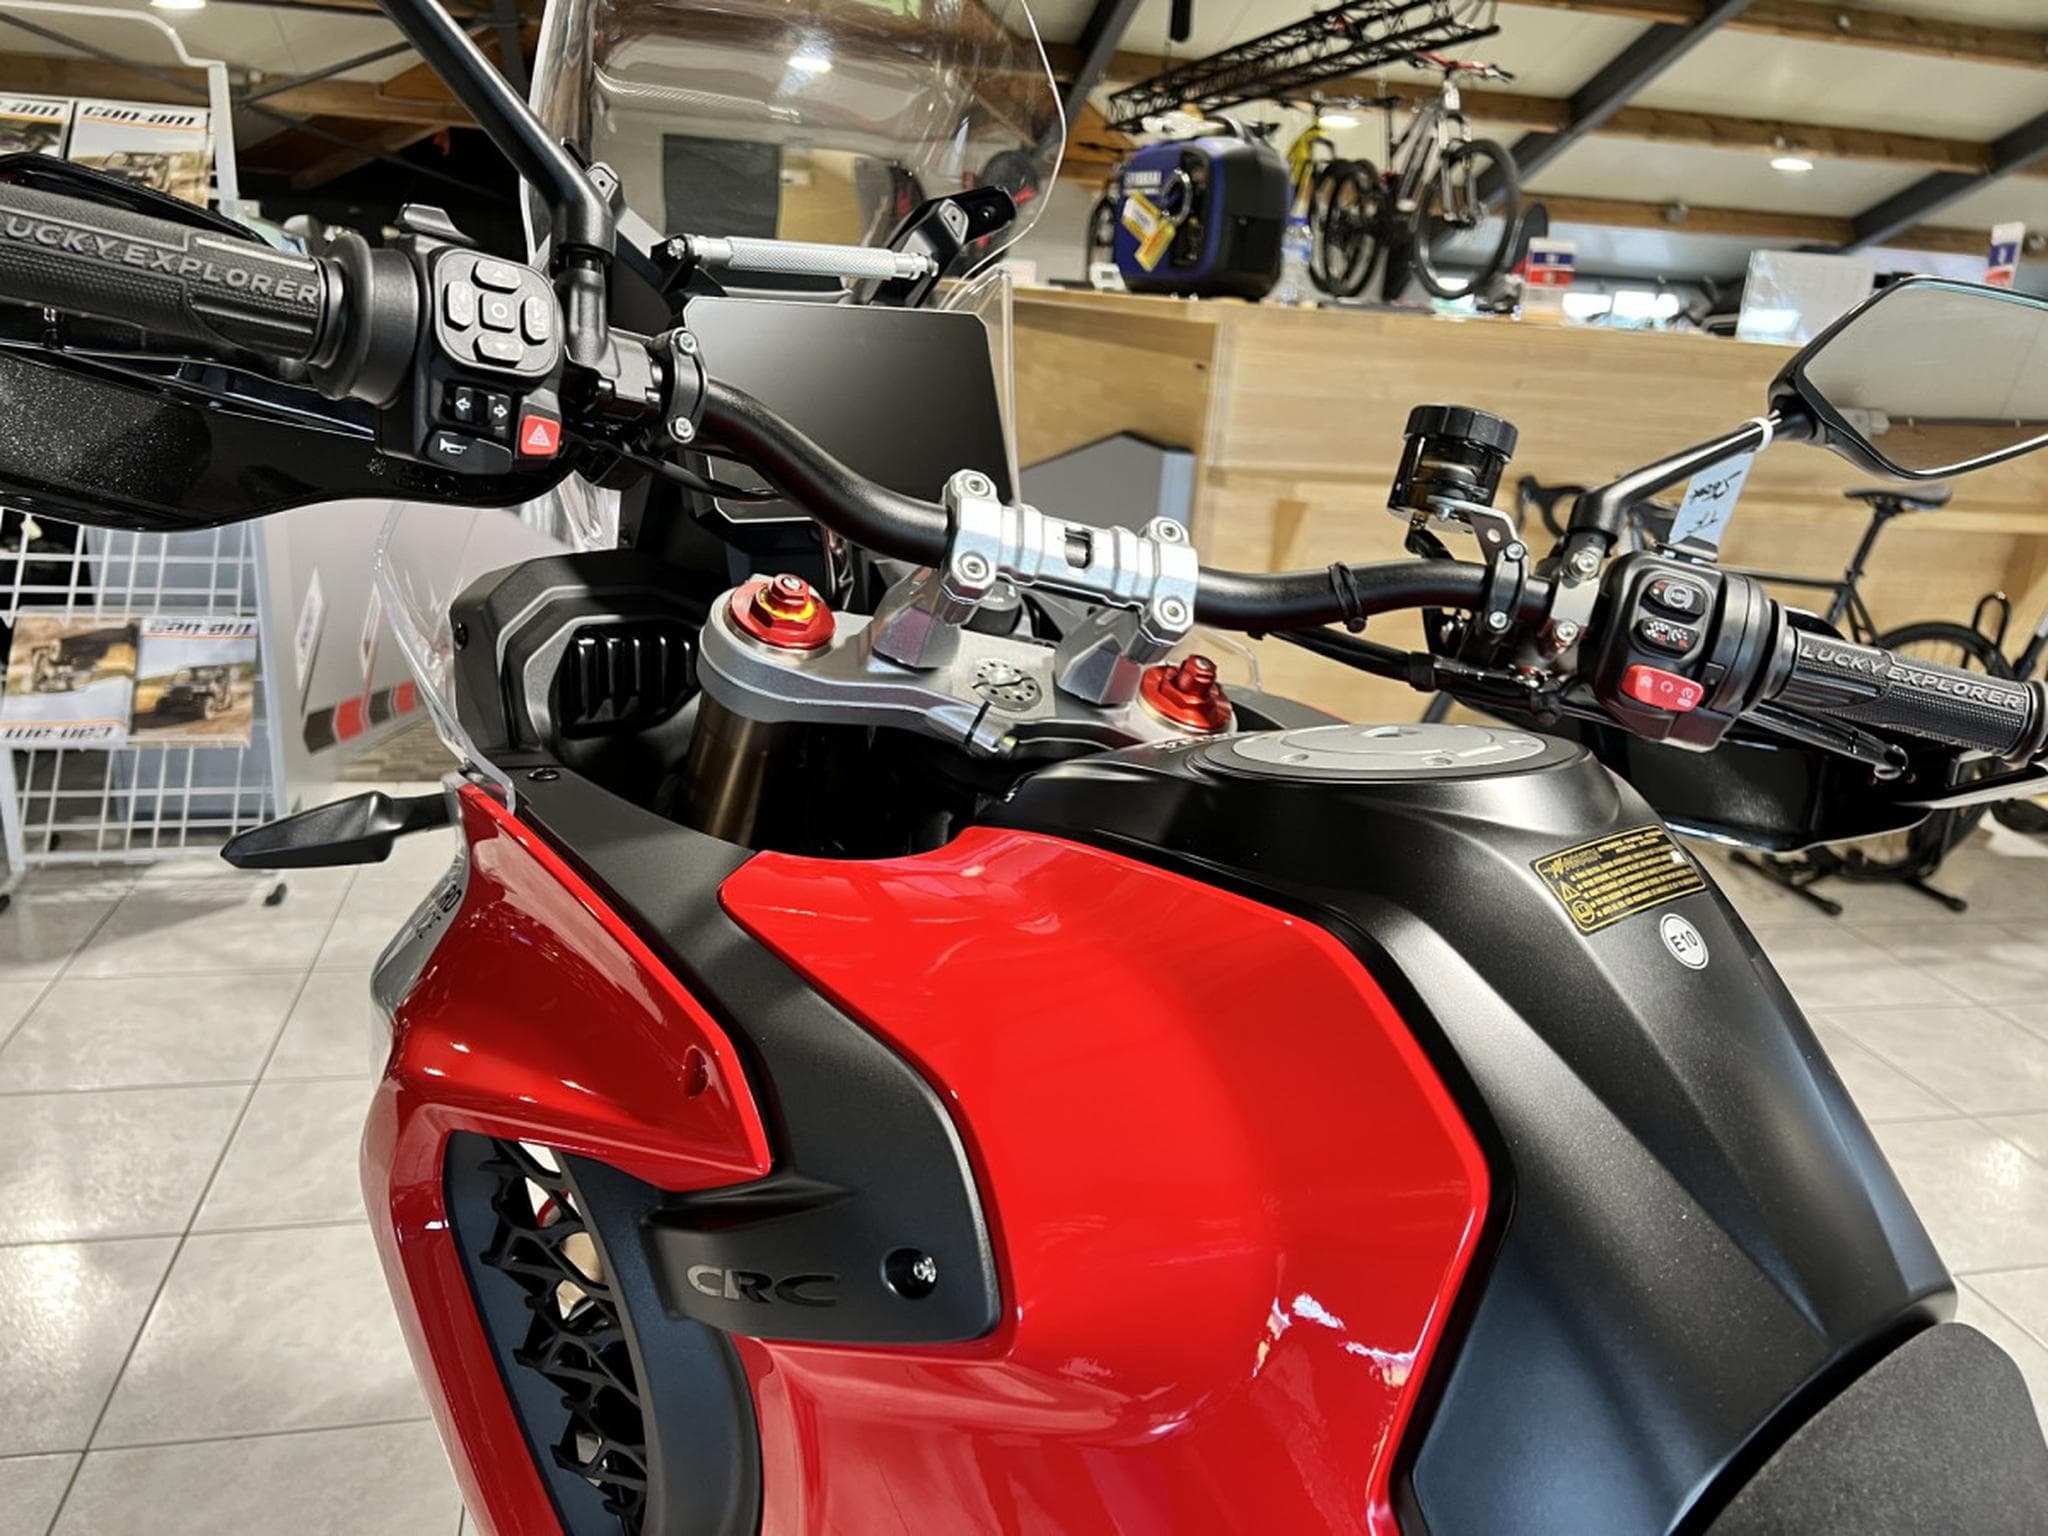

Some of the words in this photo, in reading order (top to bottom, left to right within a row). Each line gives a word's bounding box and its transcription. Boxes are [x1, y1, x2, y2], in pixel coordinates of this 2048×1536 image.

[5, 216, 120, 257] UCKY
[123, 244, 320, 305] EXPLORER
[1801, 643, 1886, 675] LUCKY
[1887, 665, 2021, 709] EXPLORER
[1670, 930, 1698, 953] E10
[687, 1264, 840, 1308] CRC
